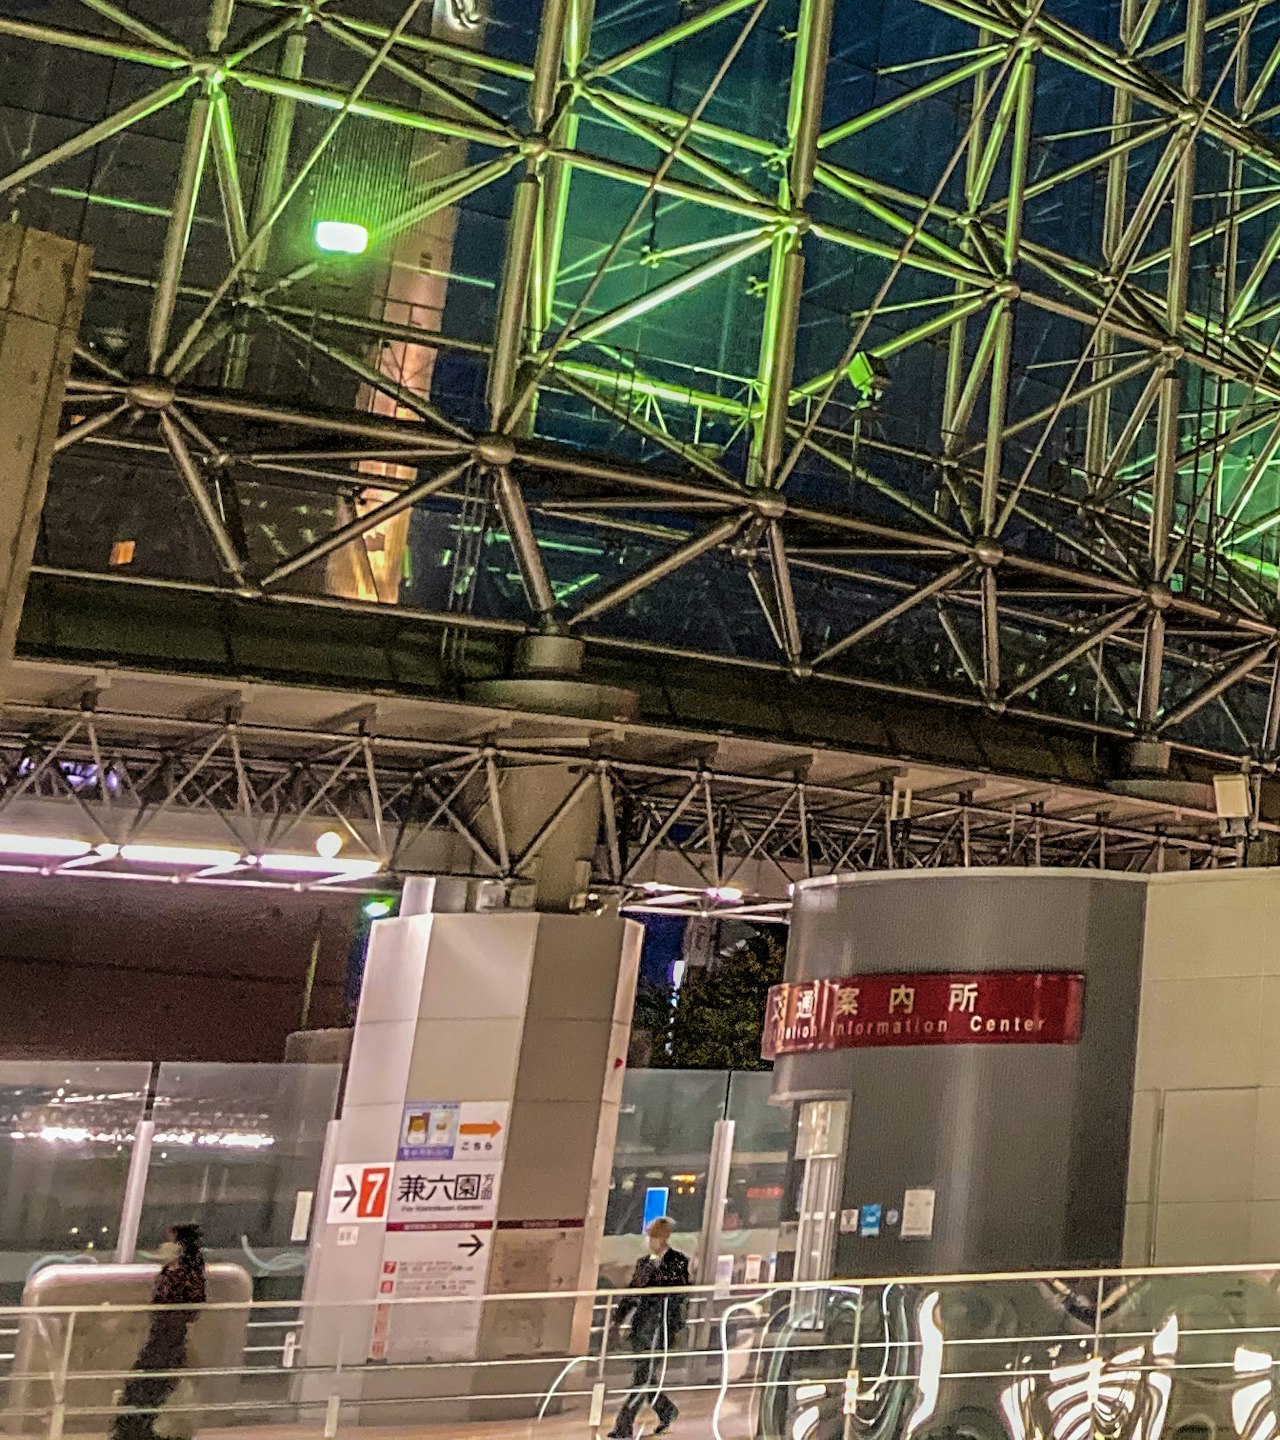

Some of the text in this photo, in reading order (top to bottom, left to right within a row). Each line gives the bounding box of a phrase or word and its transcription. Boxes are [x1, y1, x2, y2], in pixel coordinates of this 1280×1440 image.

[830, 1018, 949, 1039] Information
[969, 1014, 1046, 1033] Center
[461, 1141, 494, 1151] こちら
[365, 1172, 385, 1214] 7
[397, 1173, 482, 1202] 兼六園
